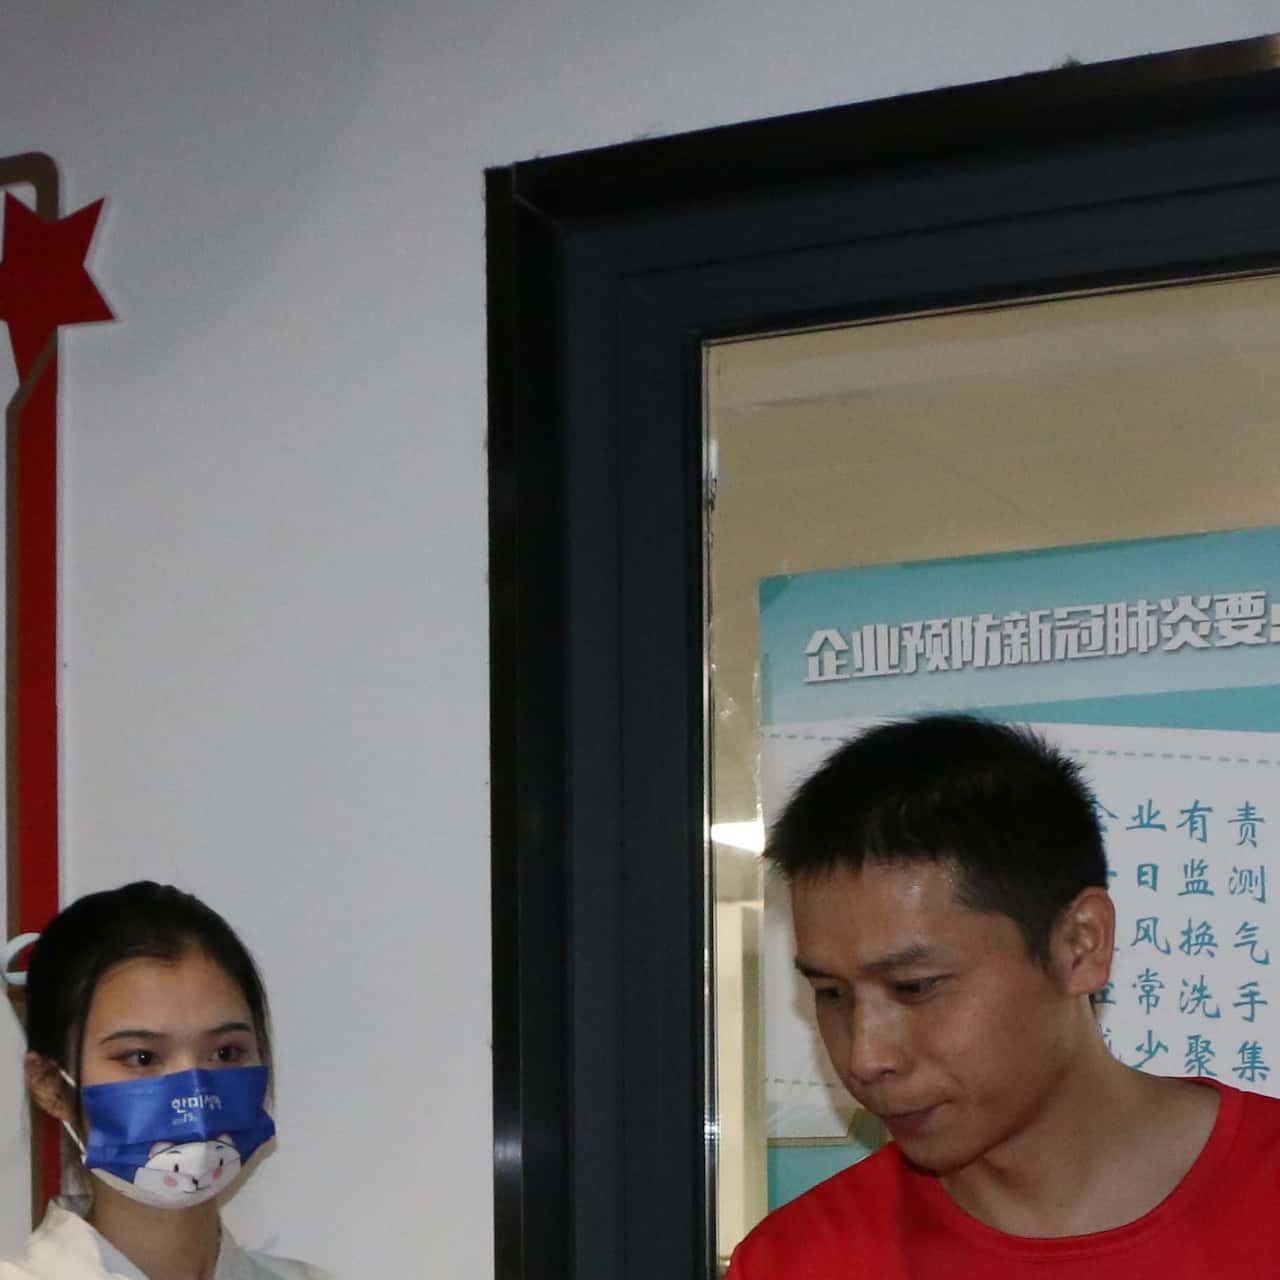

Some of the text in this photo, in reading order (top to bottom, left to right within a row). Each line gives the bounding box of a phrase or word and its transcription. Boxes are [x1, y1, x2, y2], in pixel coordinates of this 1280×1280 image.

[1108, 858, 1267, 904] 日监测
[1114, 917, 1270, 965] 风换气
[1098, 1025, 1271, 1083] 少聚集
